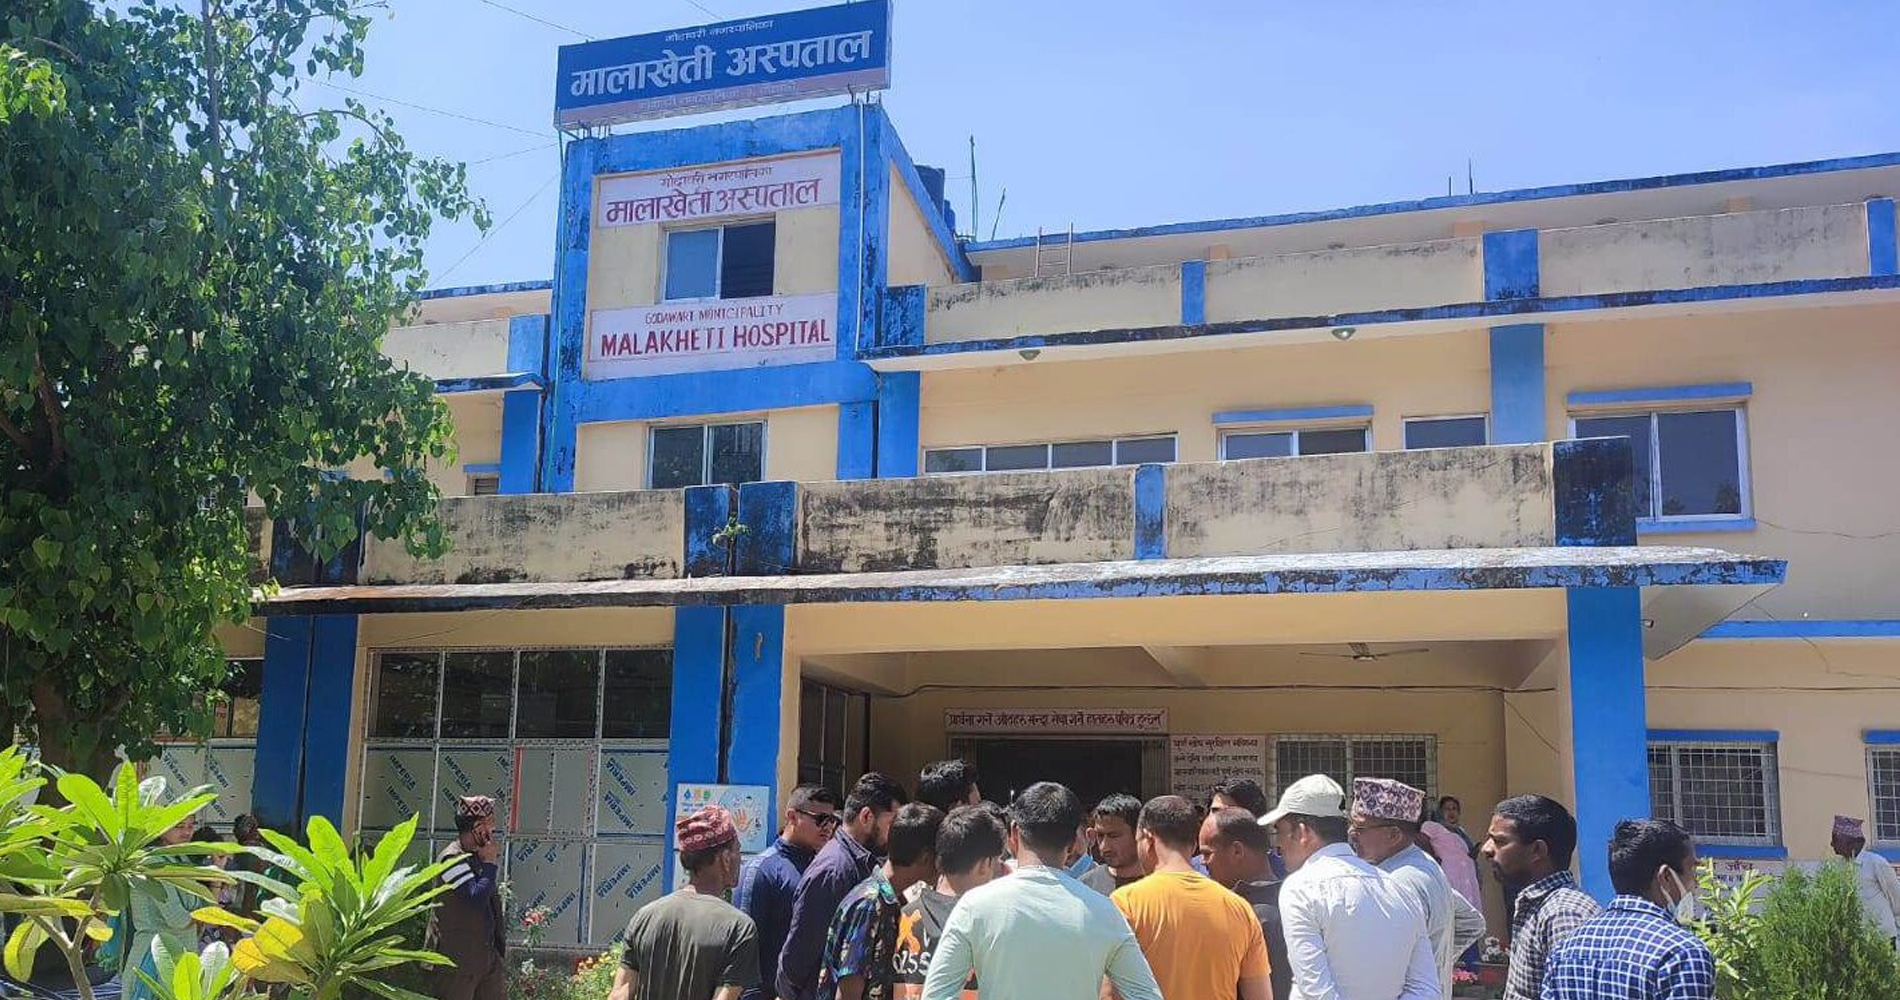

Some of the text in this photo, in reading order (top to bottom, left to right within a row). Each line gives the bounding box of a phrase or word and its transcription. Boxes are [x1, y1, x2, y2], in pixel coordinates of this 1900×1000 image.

[570, 30, 874, 97] मालाखेती अस्पताल
[716, 178, 822, 213] अस्पताल
[601, 319, 830, 356] MALAKHETI HOSPITAL
[606, 759, 637, 797] IMPERIA
[604, 794, 635, 830] IMPERIA
[627, 863, 663, 899] IMPERIA
